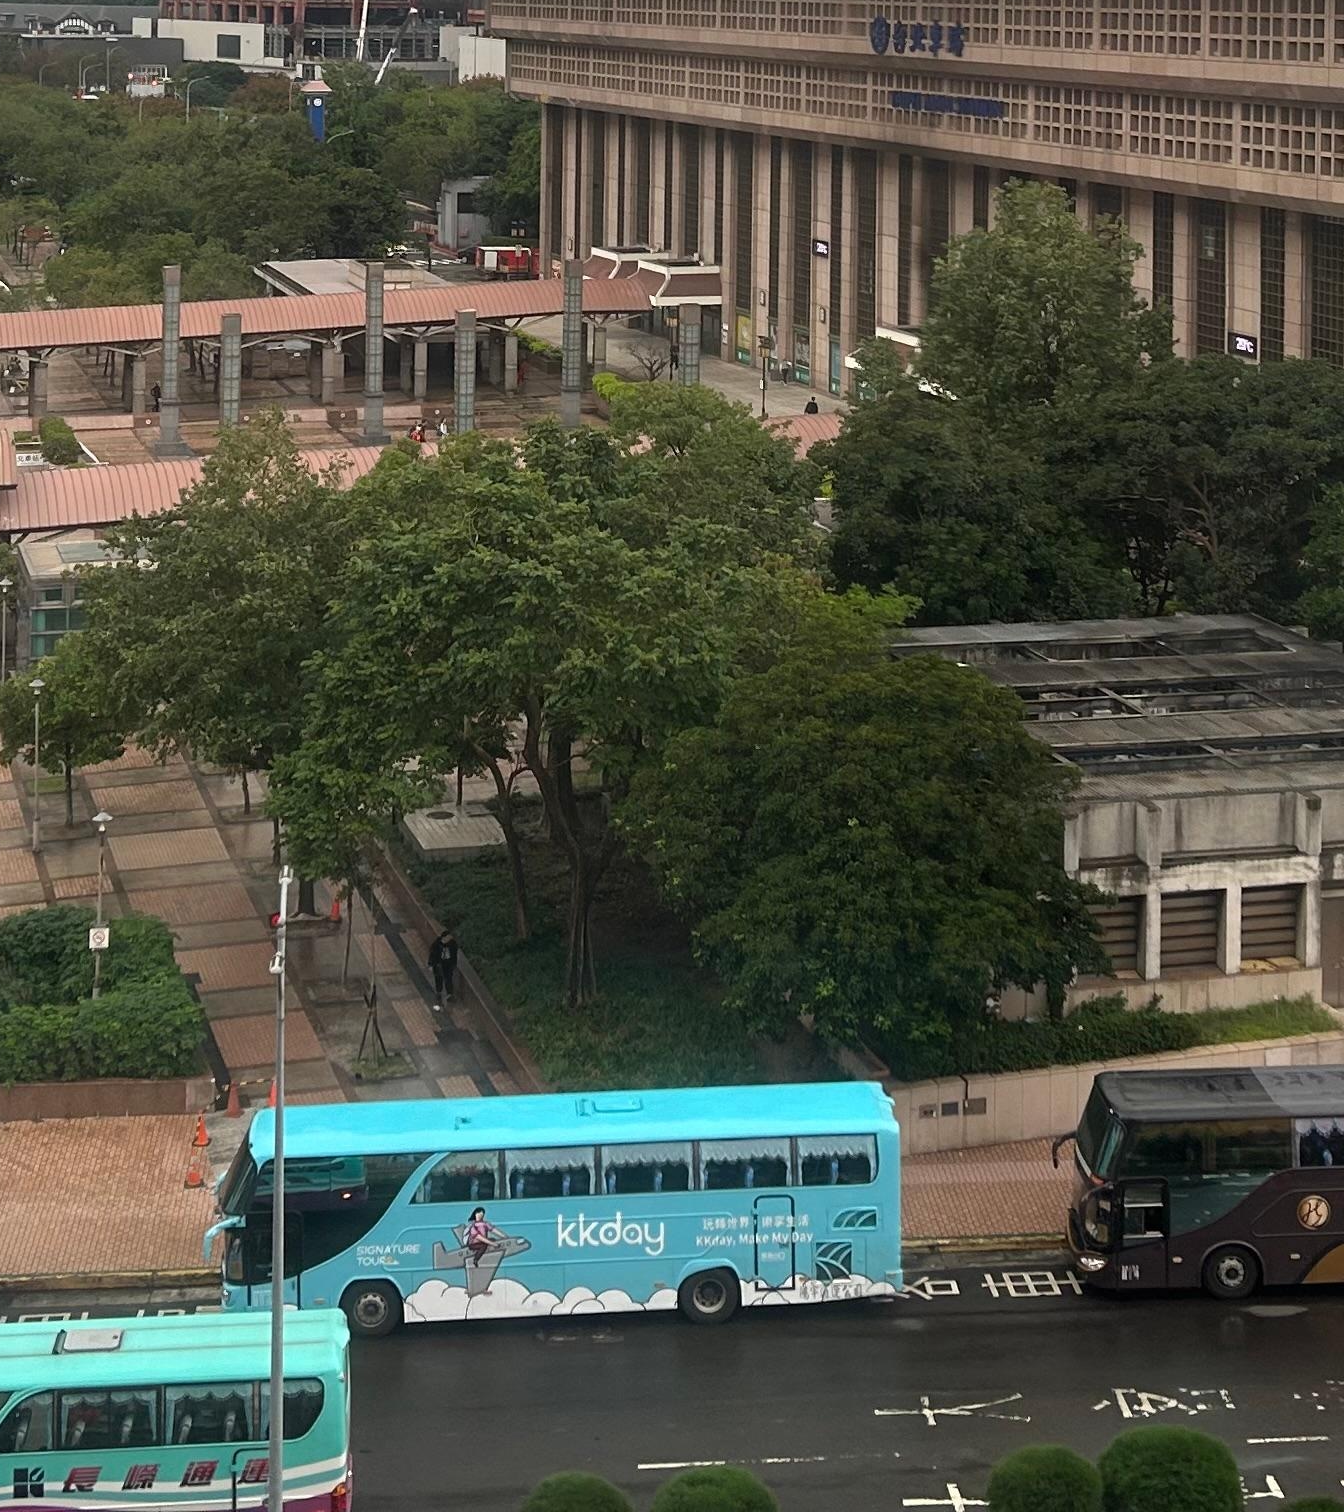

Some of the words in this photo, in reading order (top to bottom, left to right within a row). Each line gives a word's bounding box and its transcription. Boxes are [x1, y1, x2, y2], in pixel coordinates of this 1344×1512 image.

[557, 1211, 665, 1256] kkday
[772, 1231, 789, 1244] My
[792, 1231, 813, 1243] Day
[357, 1244, 421, 1256] SIGNATURE
